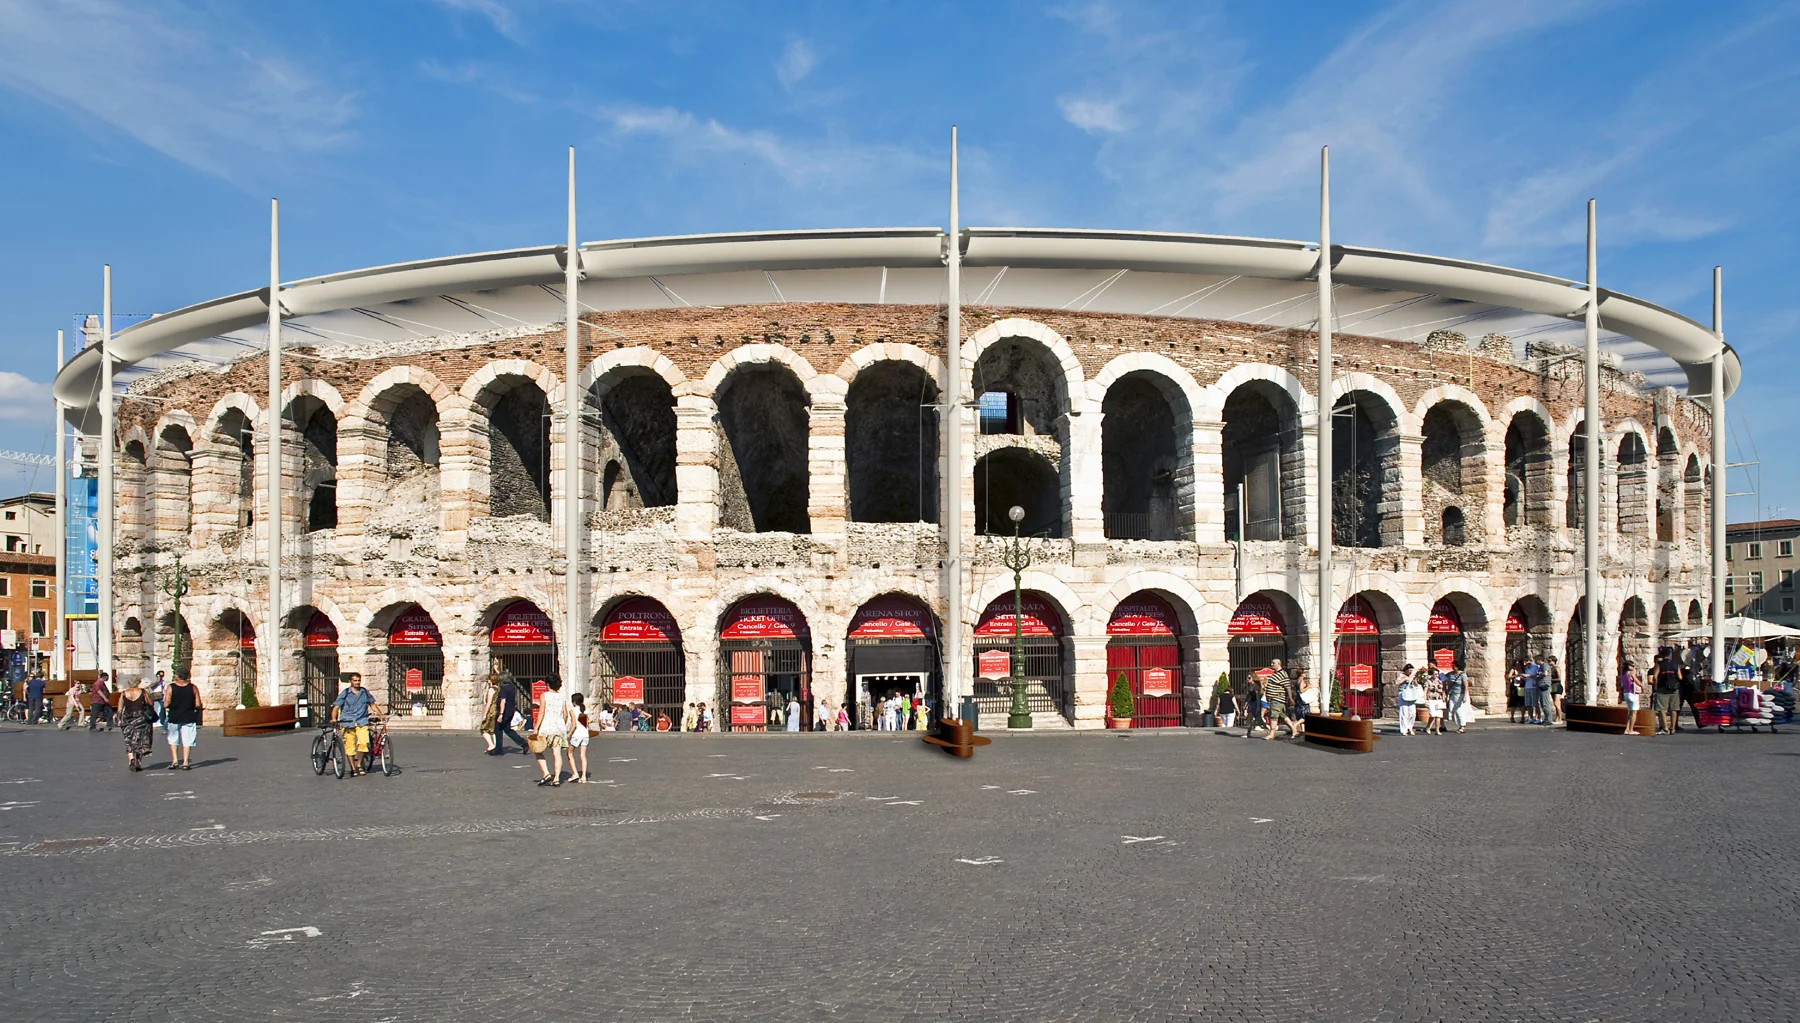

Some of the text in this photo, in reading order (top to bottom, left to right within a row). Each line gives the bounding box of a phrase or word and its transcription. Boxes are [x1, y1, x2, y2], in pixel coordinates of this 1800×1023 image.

[740, 607, 792, 615] BIGLIETTERIA
[987, 603, 1045, 611] GRADNATA
[894, 609, 922, 617] SHOP
[767, 614, 794, 622] OFFICE
